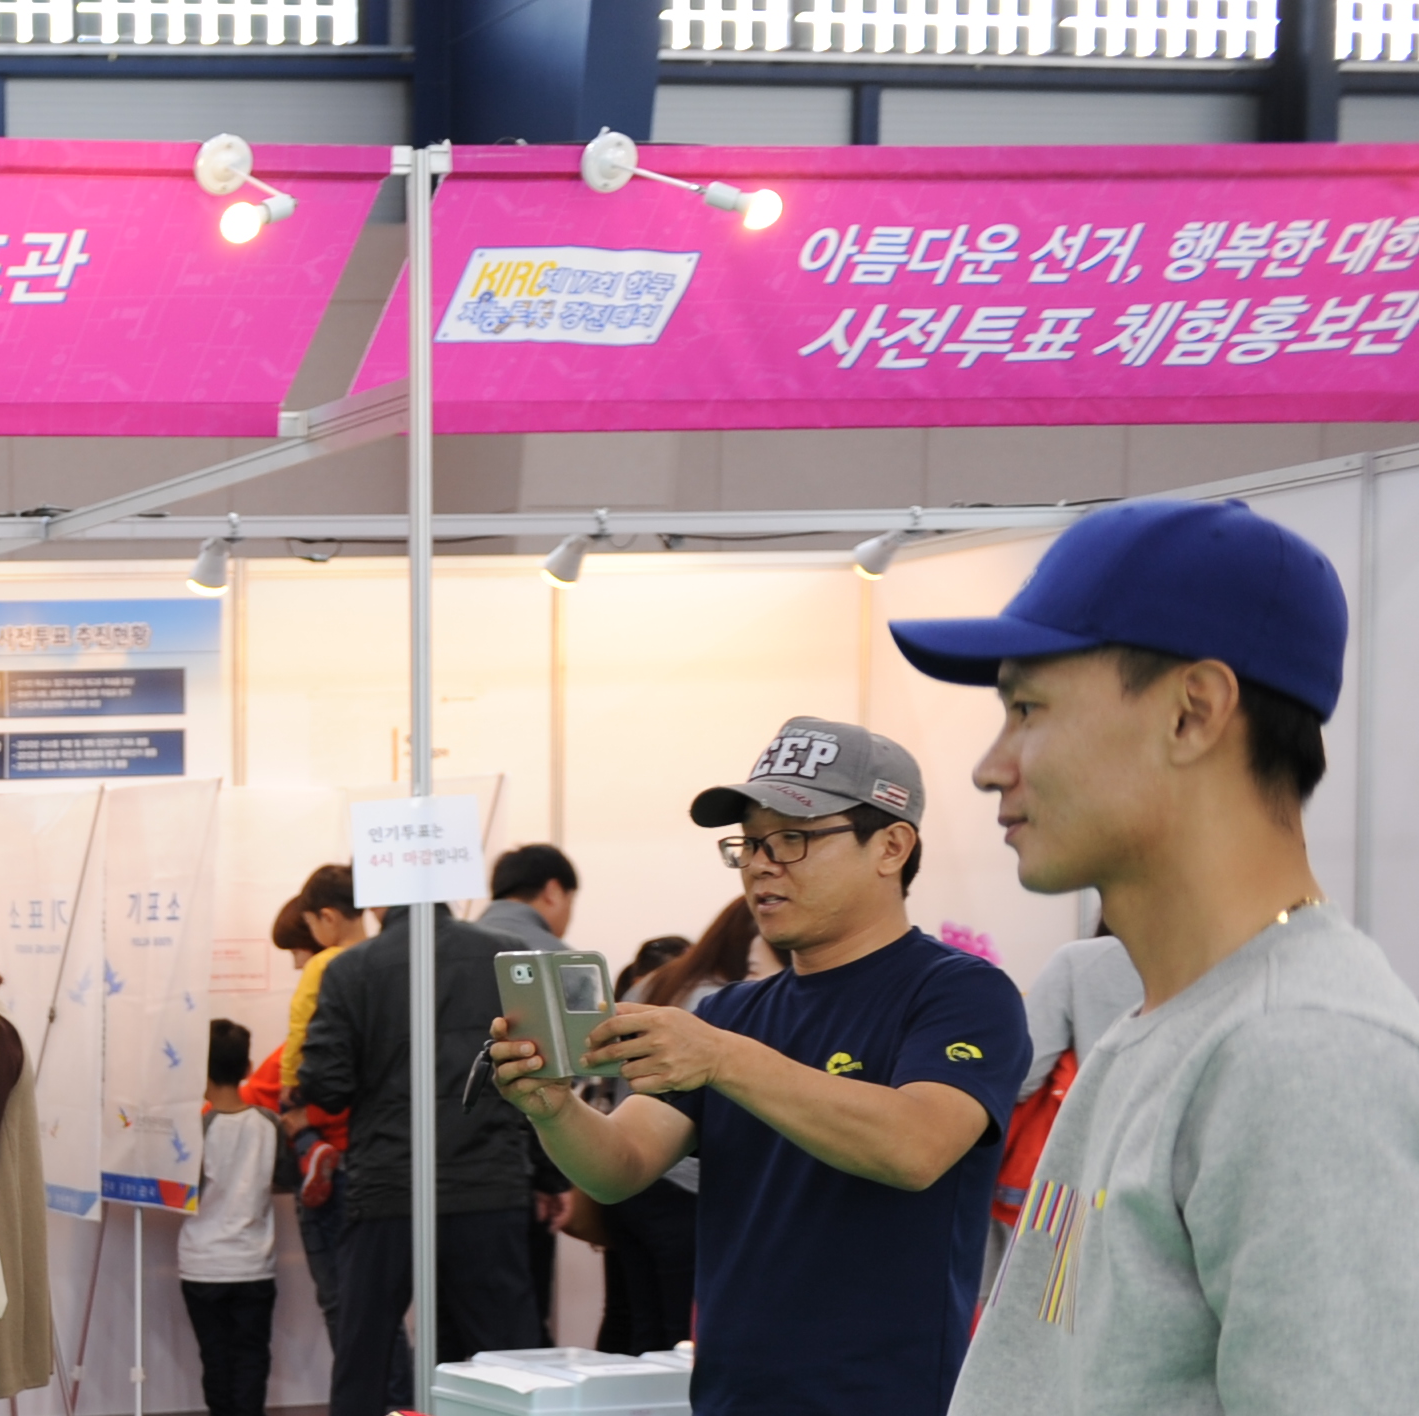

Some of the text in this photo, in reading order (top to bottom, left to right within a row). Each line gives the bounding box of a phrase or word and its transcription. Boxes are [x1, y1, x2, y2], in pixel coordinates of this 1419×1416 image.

[798, 221, 1022, 286] 아름다운
[1027, 222, 1145, 284] 선거,
[1163, 219, 1329, 282] 행복한
[798, 291, 1419, 371] 사전투표 체험홍보관
[74, 622, 152, 649] 추진현황
[749, 736, 840, 780] EEP
[127, 890, 181, 924] 기표소
